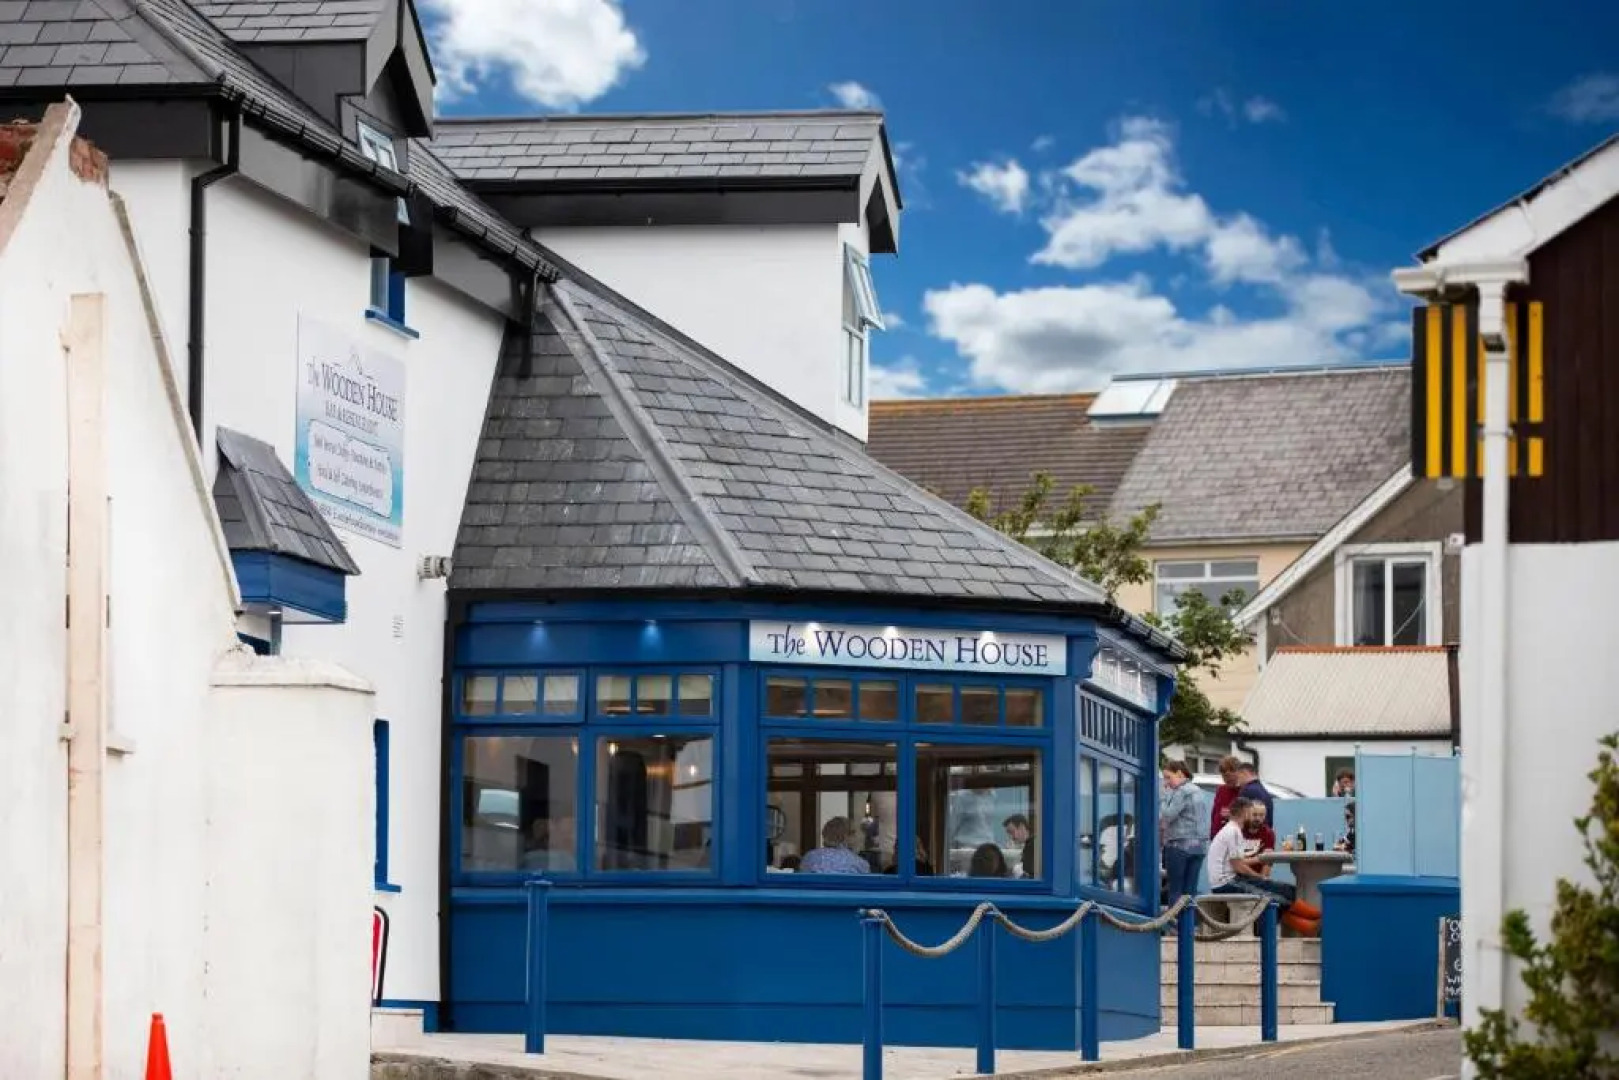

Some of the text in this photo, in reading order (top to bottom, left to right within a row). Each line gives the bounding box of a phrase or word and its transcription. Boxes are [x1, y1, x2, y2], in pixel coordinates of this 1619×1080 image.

[321, 363, 366, 407] WOODEN
[367, 383, 398, 421] HOUSE
[767, 624, 1049, 667] The WOODEN HOUSE
